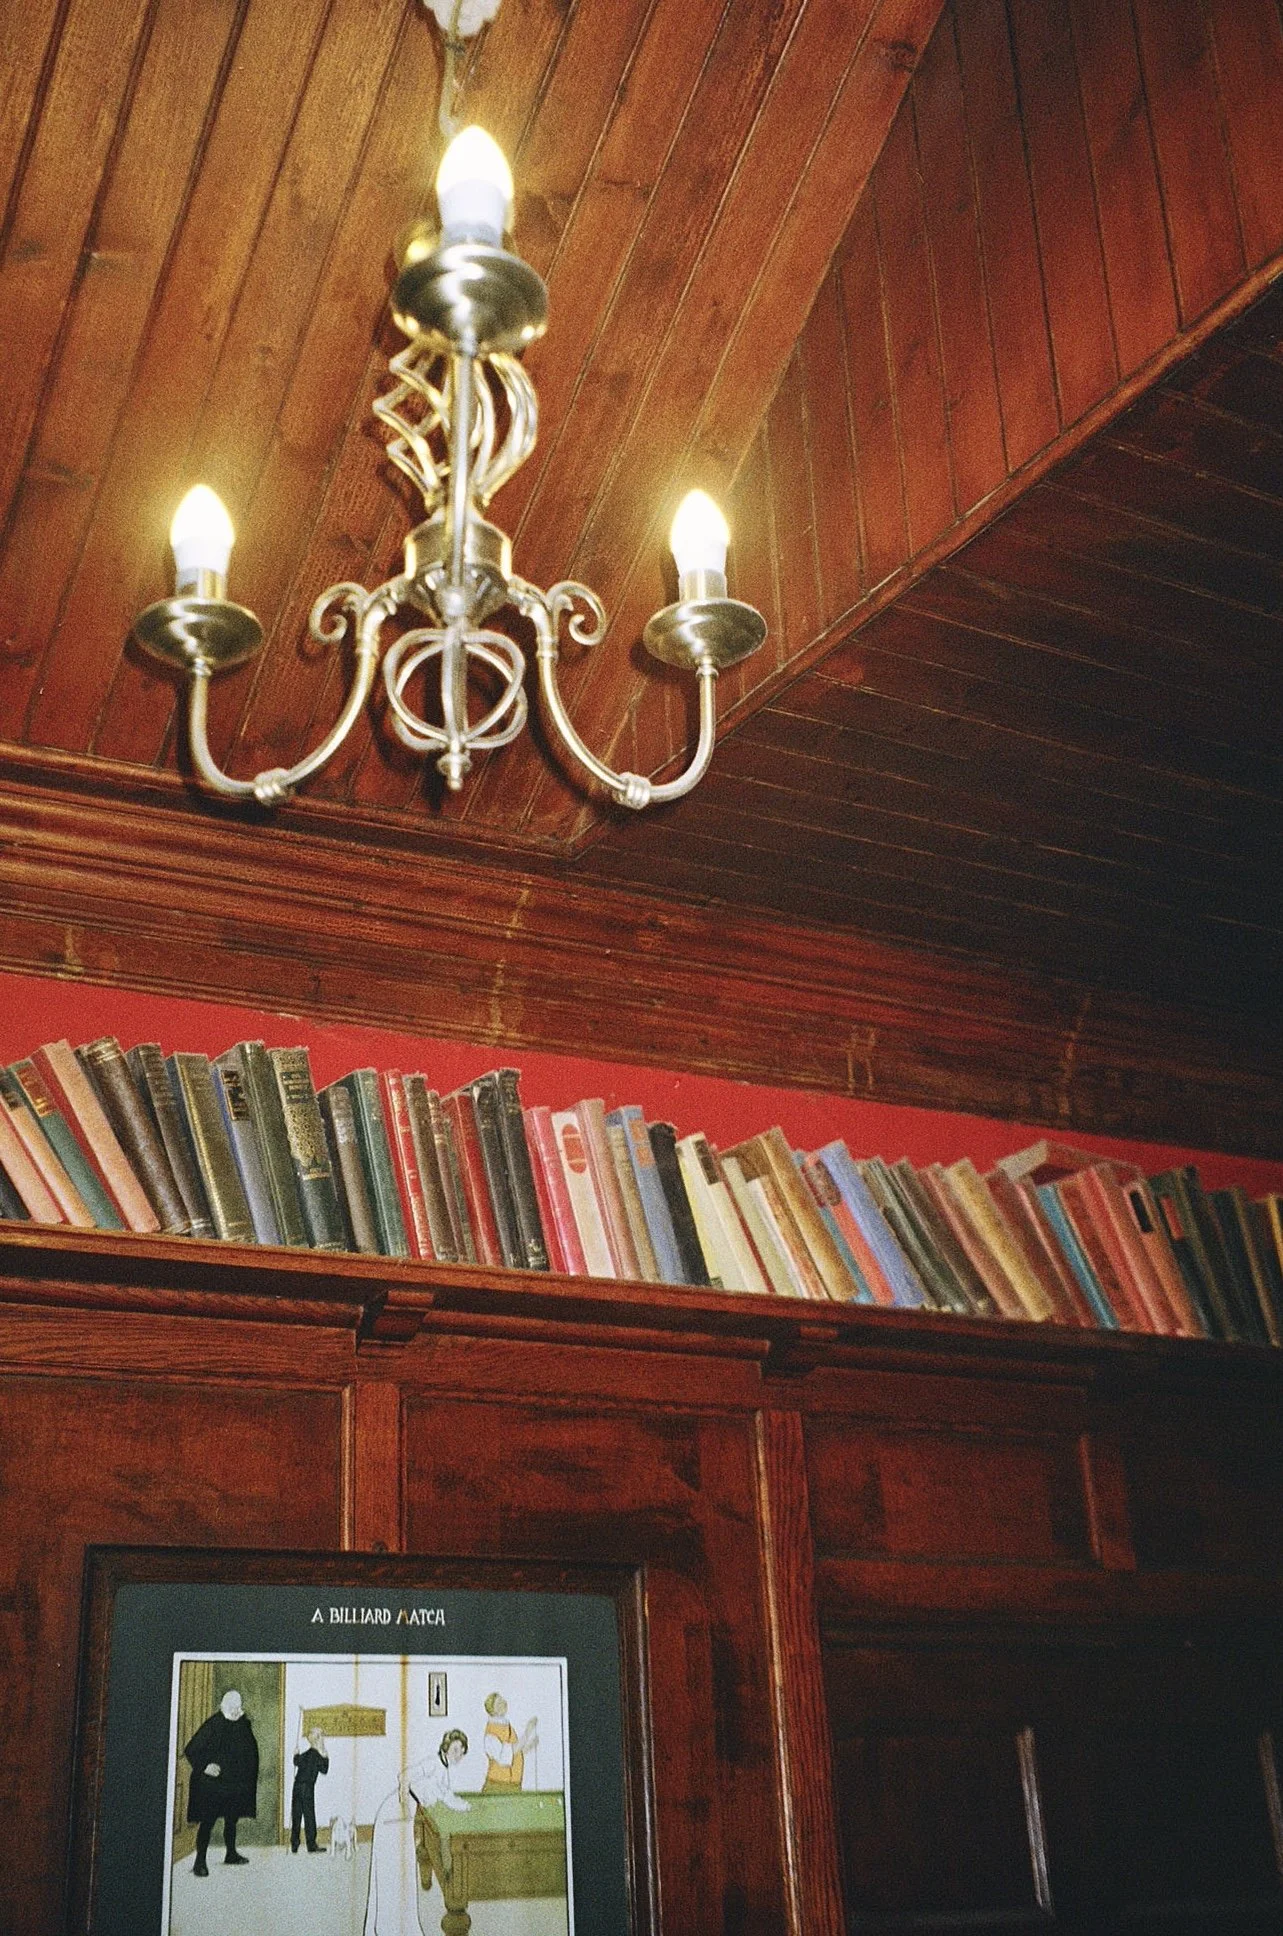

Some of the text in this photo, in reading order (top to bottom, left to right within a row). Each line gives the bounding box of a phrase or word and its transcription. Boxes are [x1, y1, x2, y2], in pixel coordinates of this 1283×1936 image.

[311, 1607, 445, 1625] A BILLIARD MATCH
